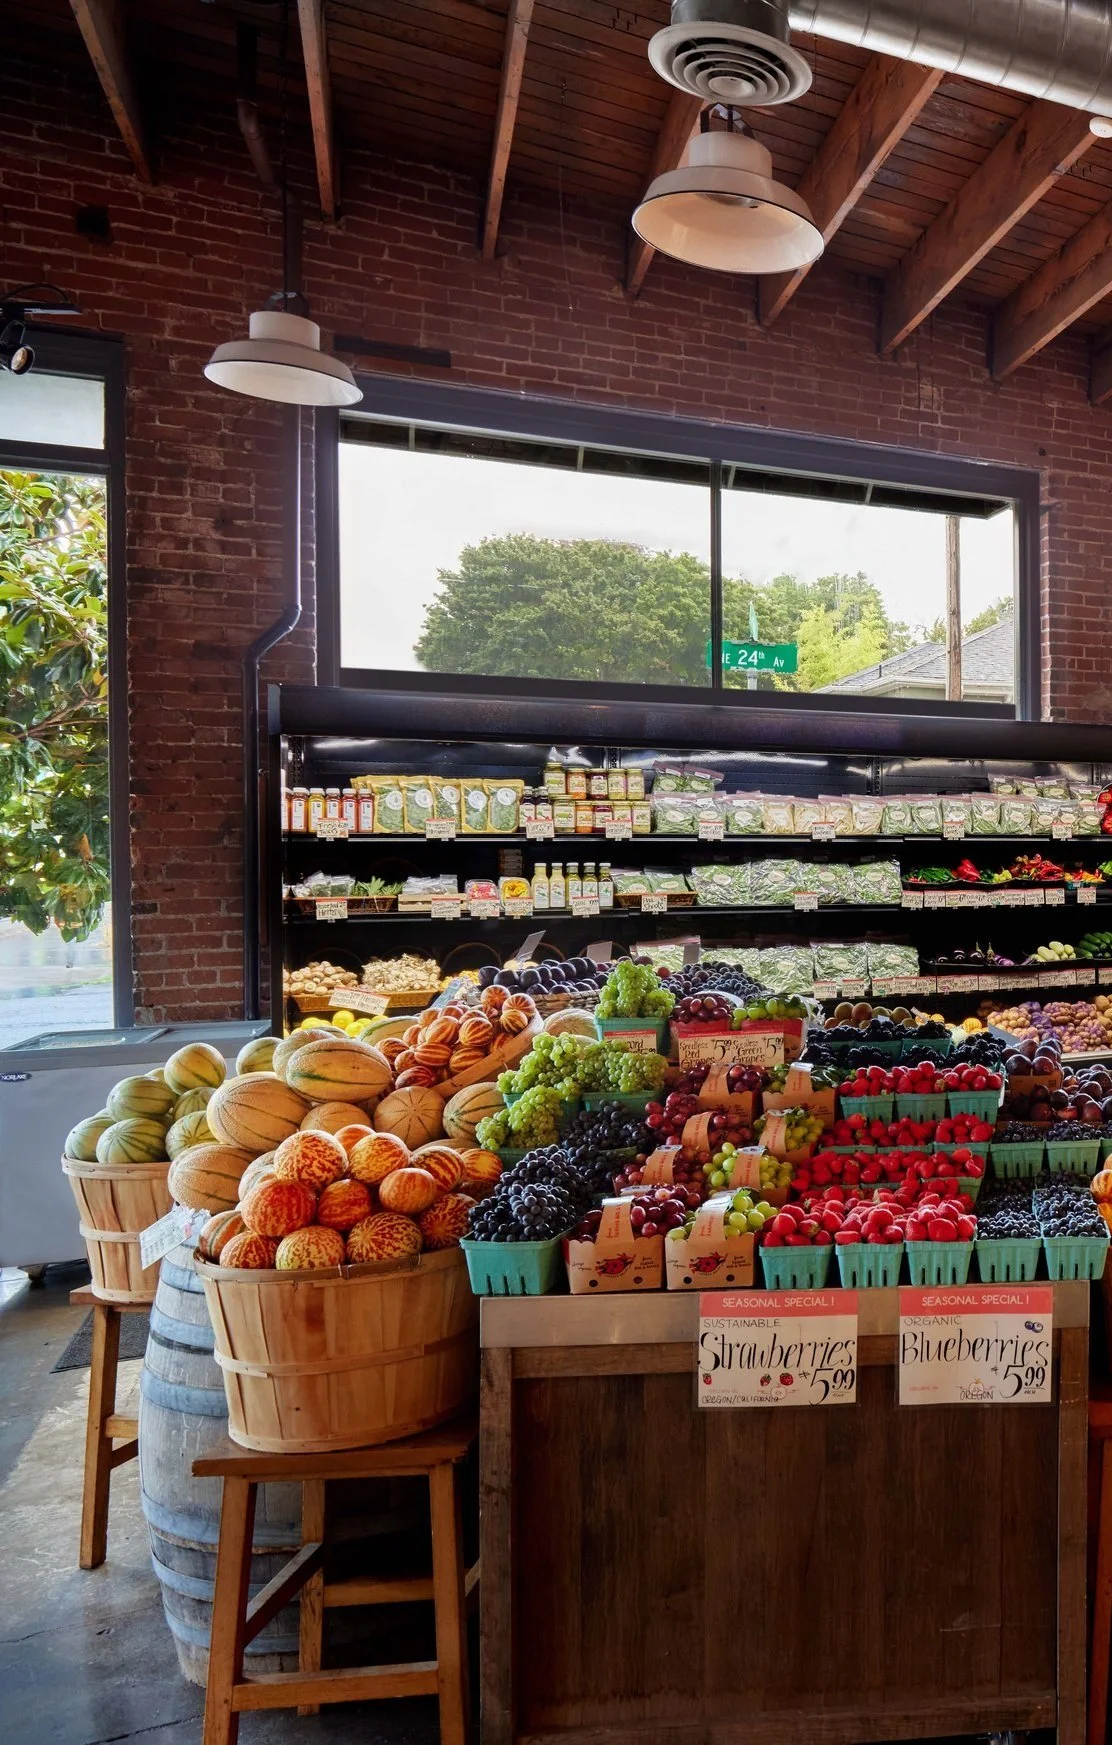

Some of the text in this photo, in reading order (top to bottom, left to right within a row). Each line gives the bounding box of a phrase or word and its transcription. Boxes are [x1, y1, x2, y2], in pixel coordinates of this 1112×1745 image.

[773, 656, 785, 668] Av
[684, 1049, 700, 1059] Red
[722, 1297, 781, 1308] SEASONAL
[921, 1296, 979, 1306] SEASONAL
[703, 1318, 781, 1328] SUSTAINABLE
[903, 1315, 962, 1326] ORGANIC
[698, 1331, 855, 1372] Strawberries
[901, 1328, 1050, 1367] Blueberries
[959, 1389, 994, 1401] OREGON
